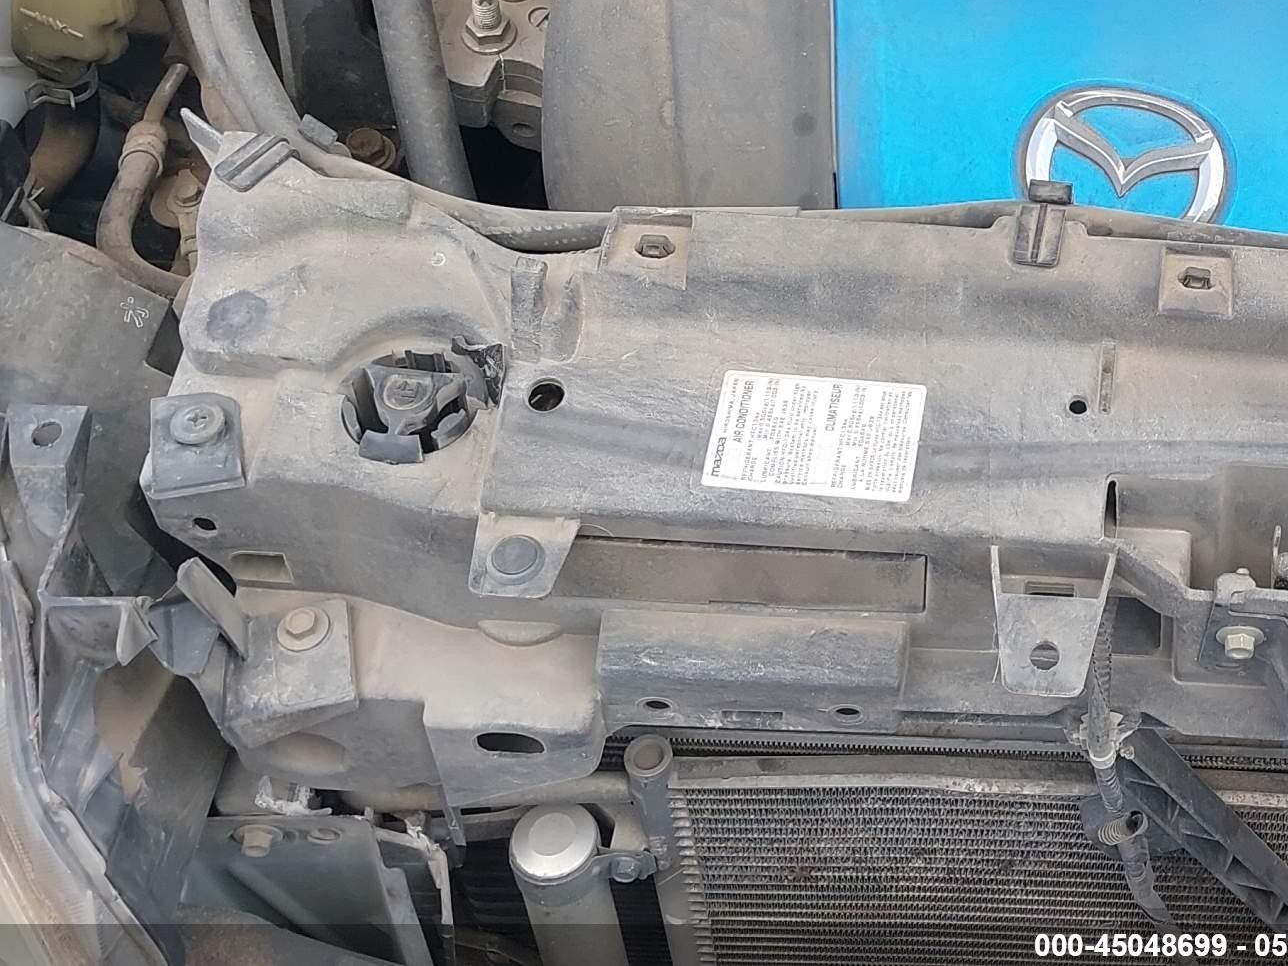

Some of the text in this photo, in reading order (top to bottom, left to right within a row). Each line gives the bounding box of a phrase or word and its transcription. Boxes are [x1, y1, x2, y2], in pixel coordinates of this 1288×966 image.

[731, 379, 755, 442] AIR CONDITIONER
[824, 383, 843, 431] CLIMATISEUR
